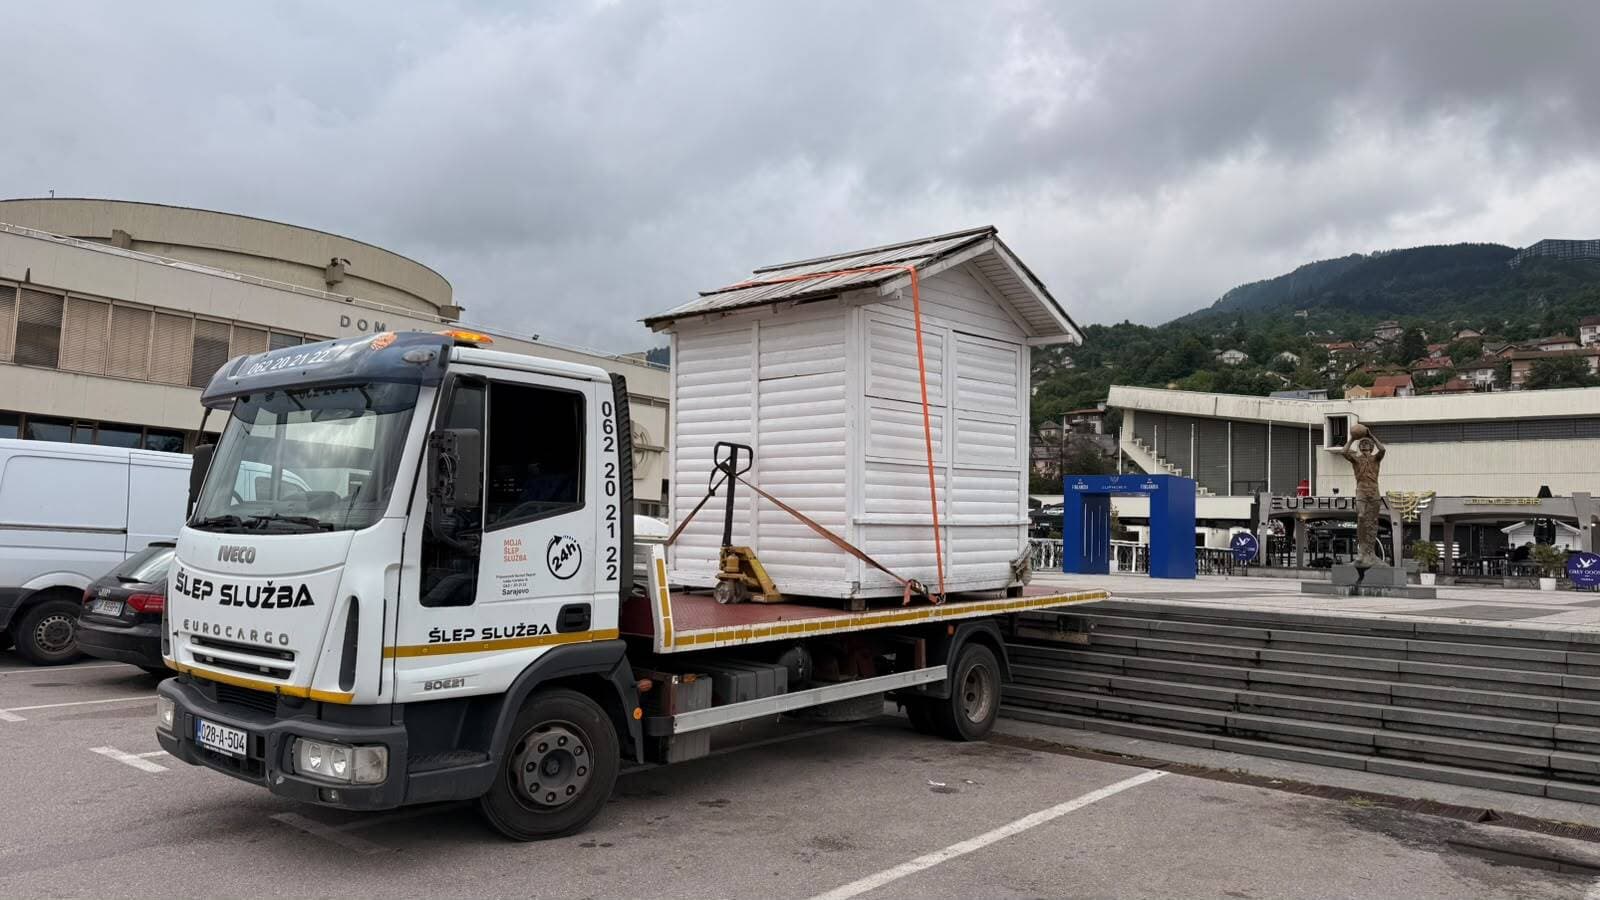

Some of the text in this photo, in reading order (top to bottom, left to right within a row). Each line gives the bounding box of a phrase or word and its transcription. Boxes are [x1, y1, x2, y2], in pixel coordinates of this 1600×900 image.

[340, 315, 386, 333] DOM
[247, 350, 330, 375] 062 20 21 22
[601, 400, 617, 581] 062 20 21 22
[503, 538, 522, 546] MOJA
[217, 545, 256, 564] IVECO
[551, 543, 577, 572] 24h
[174, 567, 315, 609] ŠLEP SLUŽBA
[502, 588, 529, 596] Sarajevo
[183, 619, 290, 646] EUROCARGO
[428, 622, 552, 643] ŠLEP SLUŽBA
[423, 678, 465, 691] 80E21
